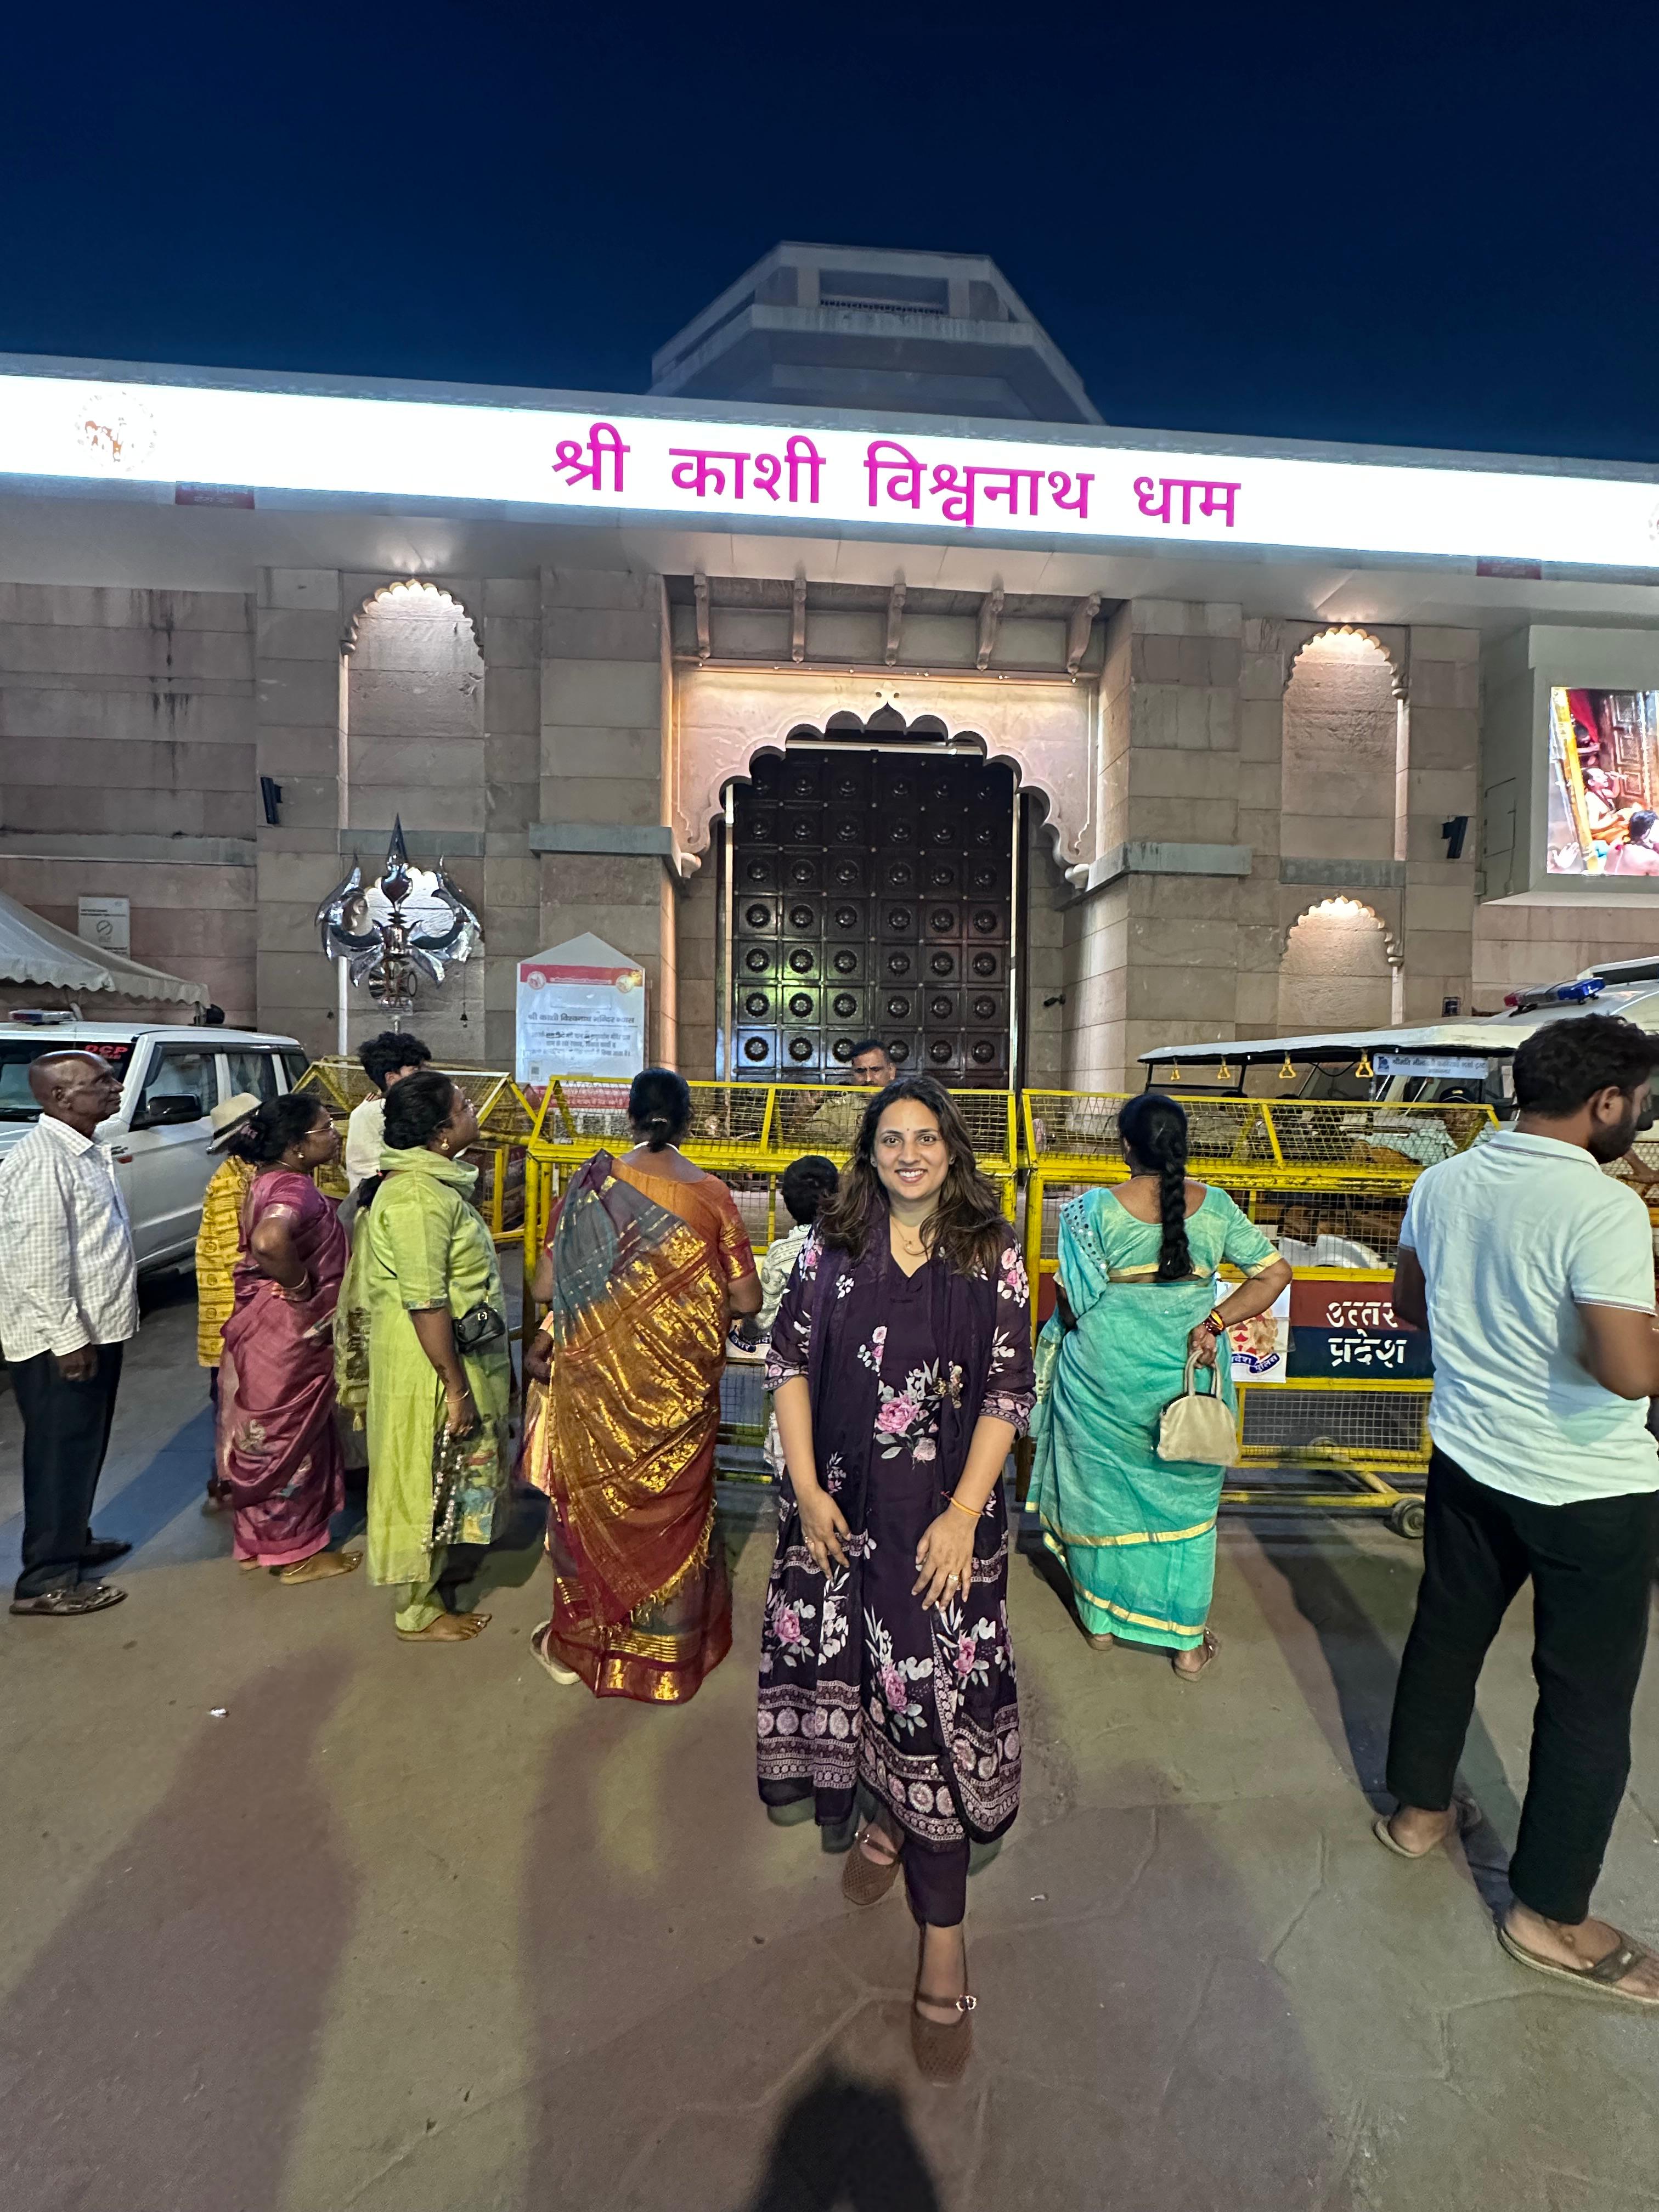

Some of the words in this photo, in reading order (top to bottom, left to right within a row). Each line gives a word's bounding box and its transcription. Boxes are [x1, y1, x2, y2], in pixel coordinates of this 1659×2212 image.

[552, 421, 630, 493] श्री
[668, 435, 826, 504] काशी
[863, 439, 1095, 528] विश्वनाथ
[1133, 476, 1242, 528] धाम
[1326, 1301, 1399, 1328] उत्तर
[1328, 1328, 1407, 1368] प्रदेश
